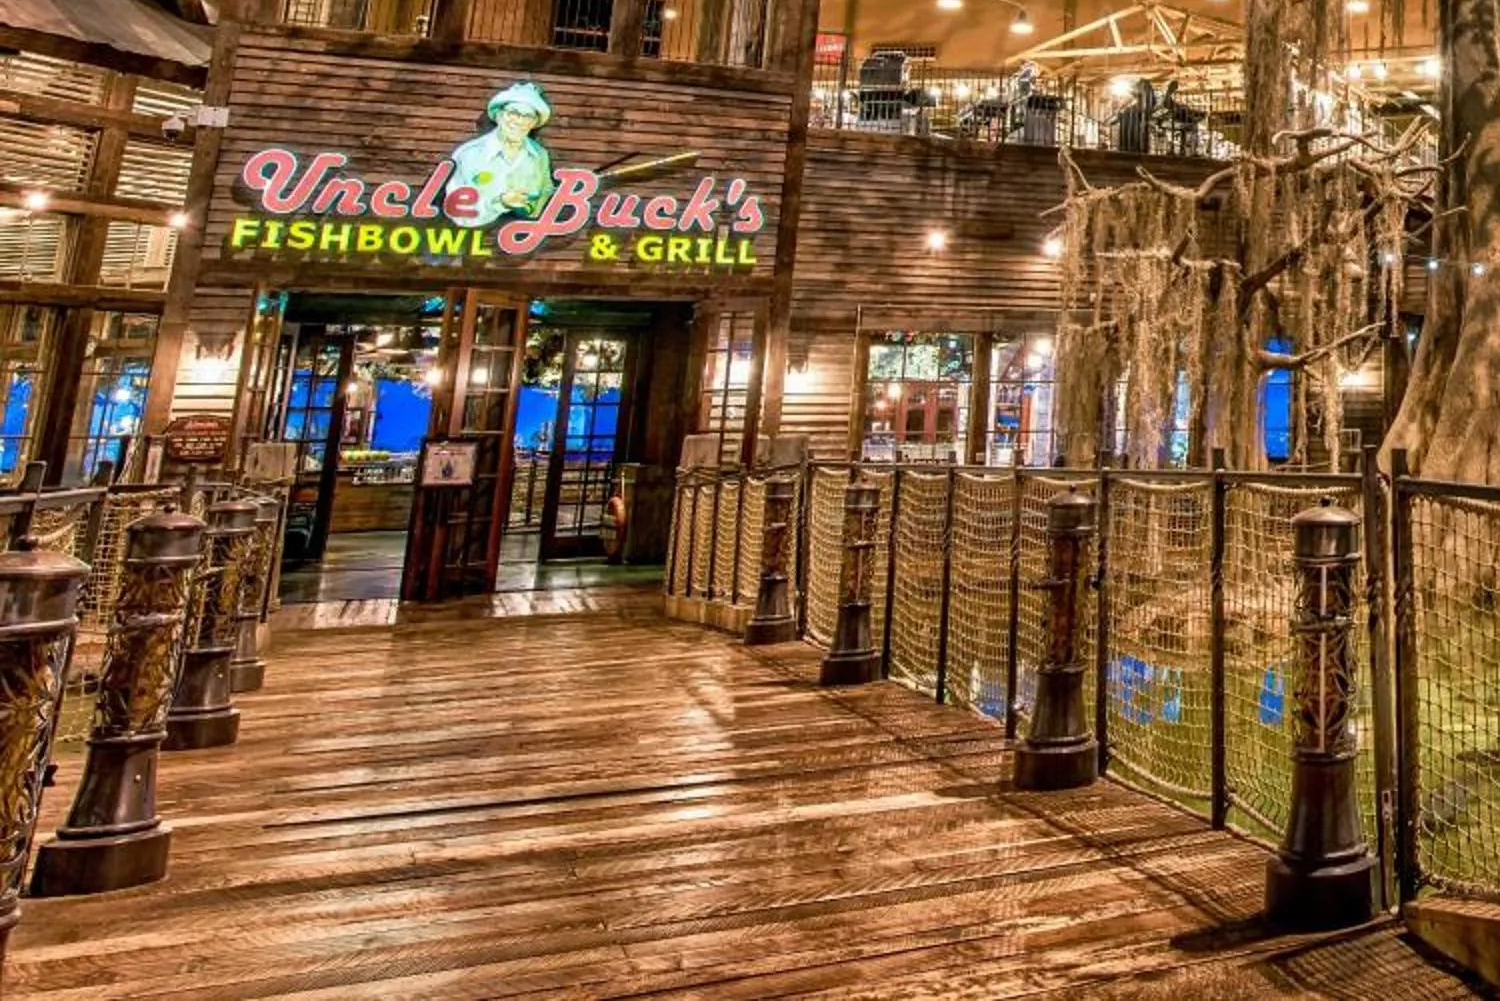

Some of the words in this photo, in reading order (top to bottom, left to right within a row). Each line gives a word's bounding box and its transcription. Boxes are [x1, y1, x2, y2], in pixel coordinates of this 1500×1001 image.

[243, 148, 480, 219] Uncle
[498, 168, 764, 254] Buck's
[231, 218, 493, 256] FISHBOWL
[589, 233, 619, 262] &
[636, 235, 758, 265] GRILL
